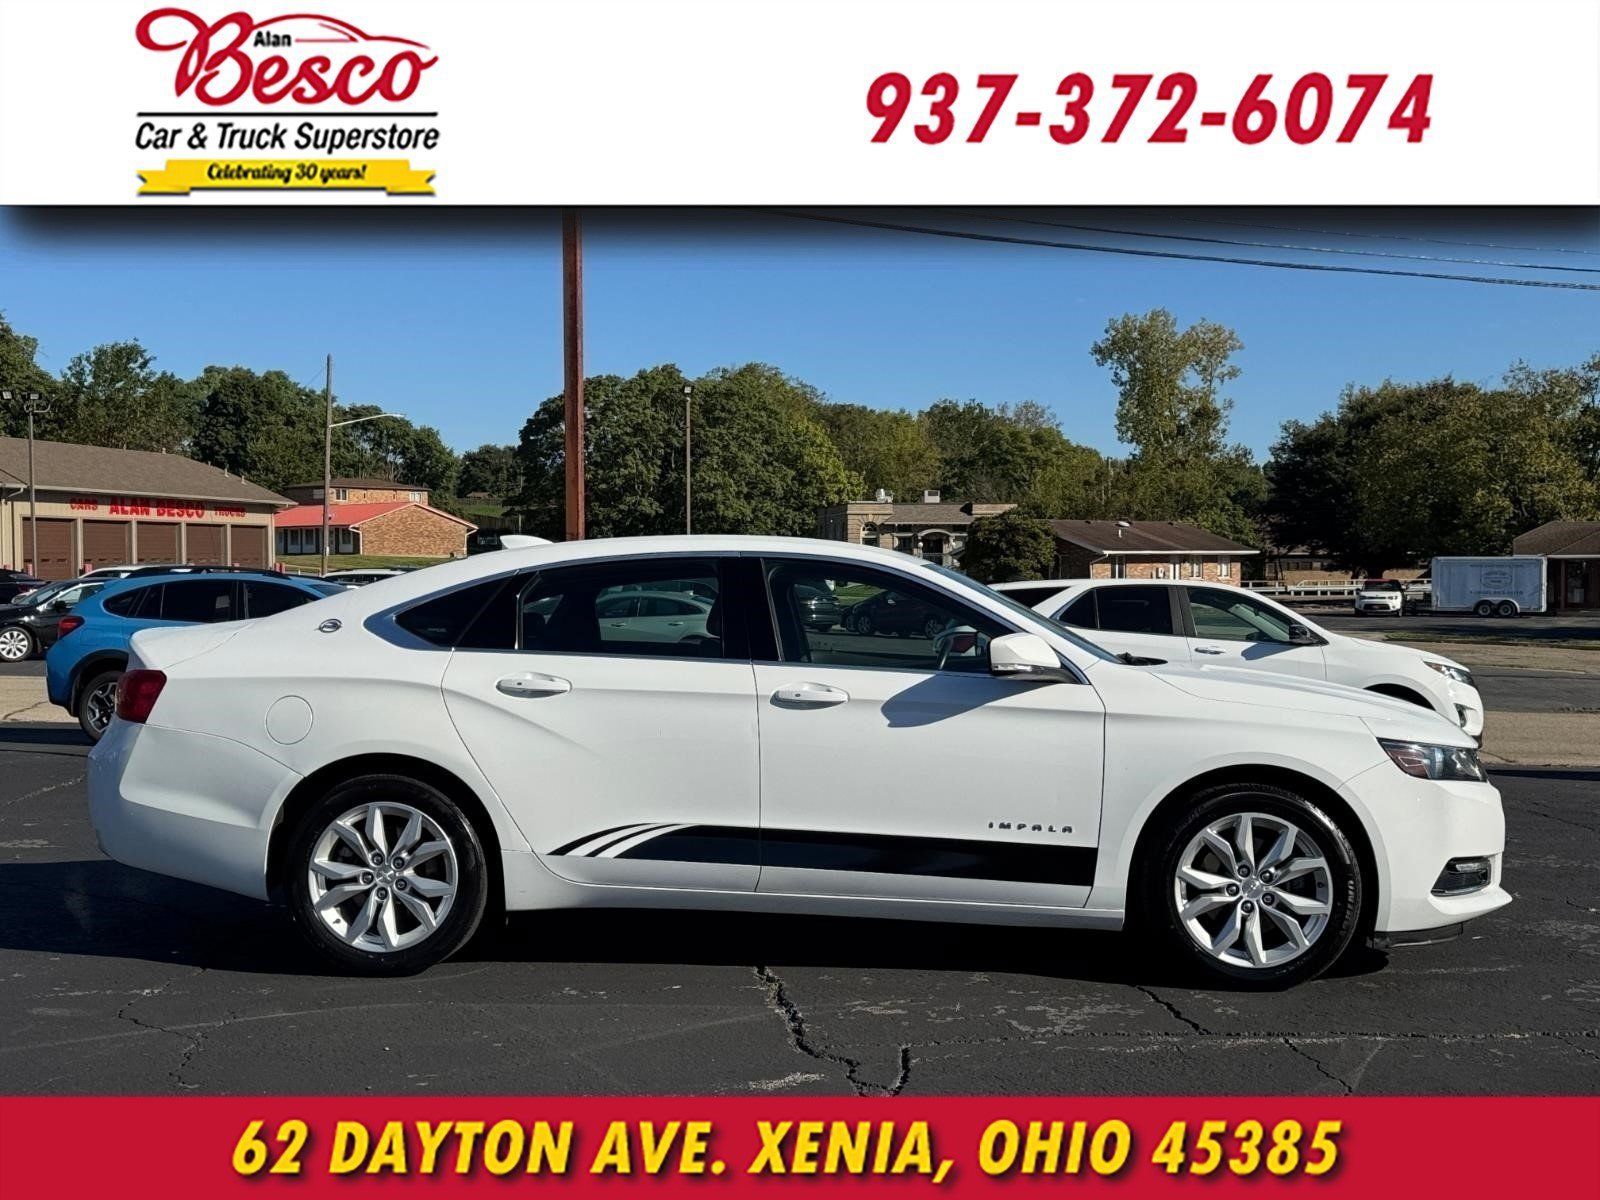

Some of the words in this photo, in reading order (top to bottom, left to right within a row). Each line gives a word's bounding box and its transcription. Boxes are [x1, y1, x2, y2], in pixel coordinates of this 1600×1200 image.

[109, 496, 150, 516] ALAN
[156, 499, 205, 518] BESCO
[988, 821, 1073, 834] IMPALA
